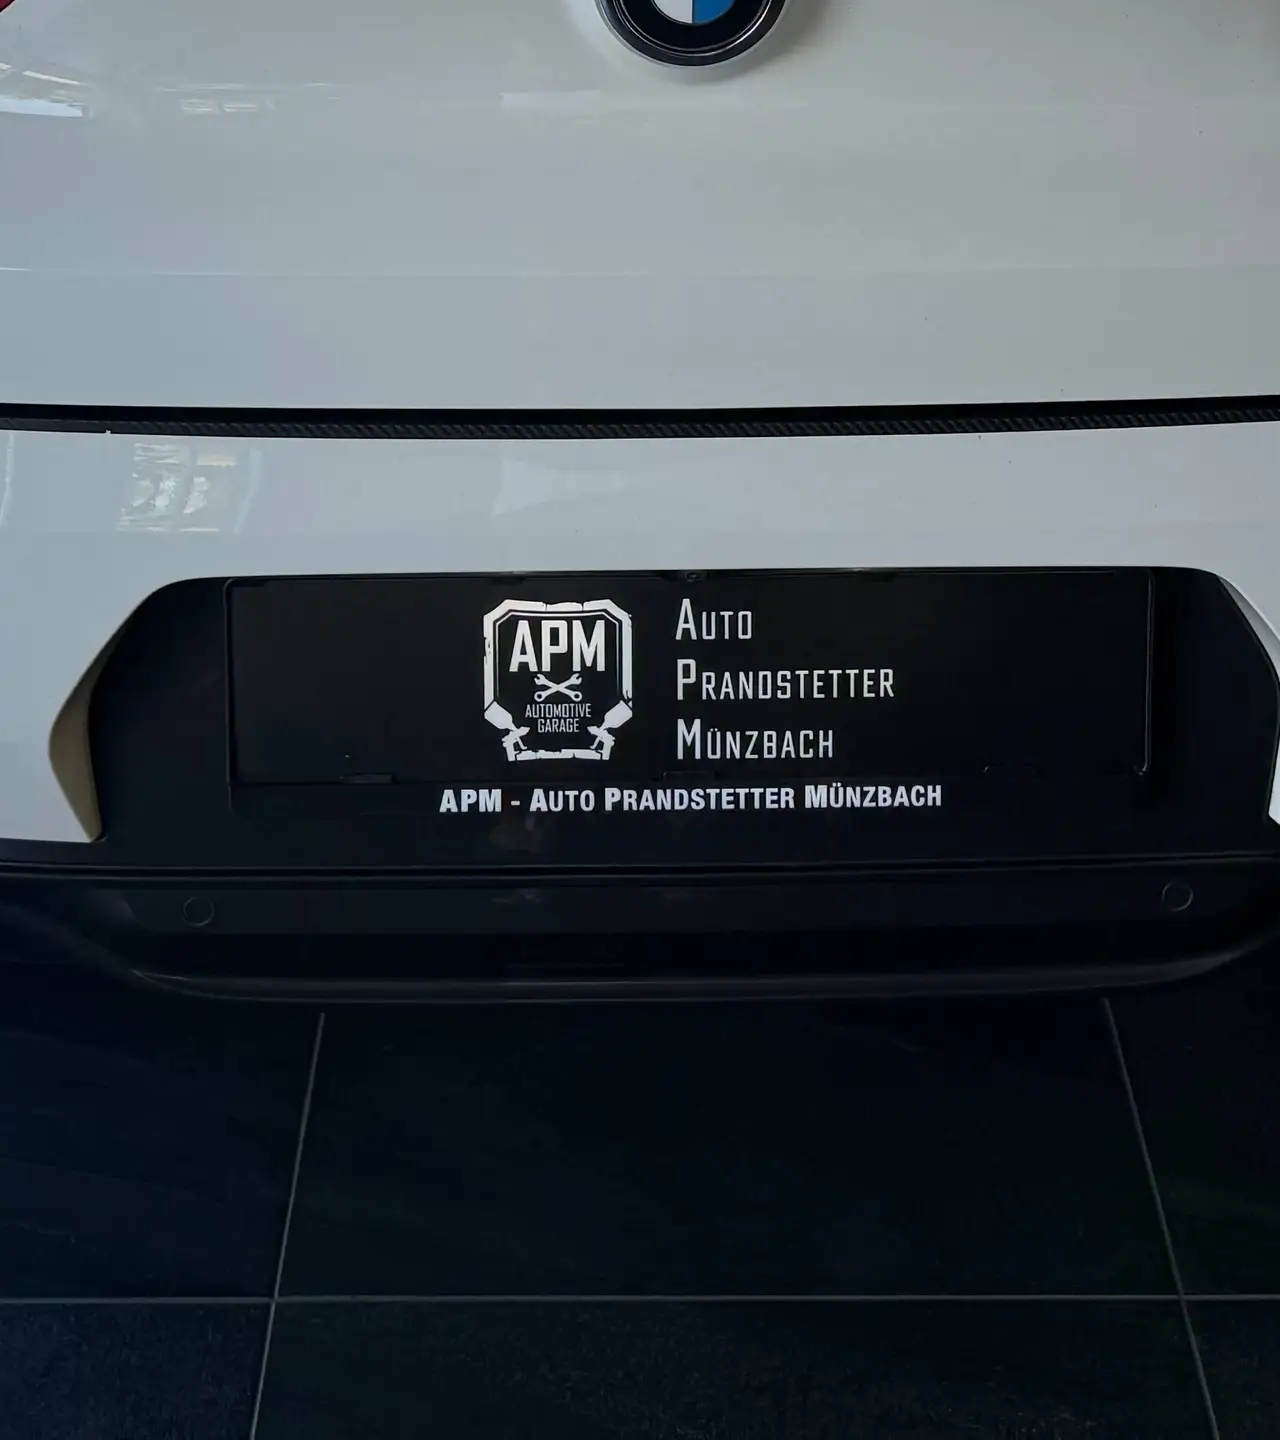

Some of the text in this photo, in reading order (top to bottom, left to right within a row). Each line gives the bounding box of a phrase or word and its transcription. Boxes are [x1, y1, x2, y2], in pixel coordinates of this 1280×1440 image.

[509, 620, 605, 672] APM
[525, 703, 592, 718] AUTOMOTIVE
[537, 718, 580, 733] GARAGE
[439, 788, 502, 813] APM
